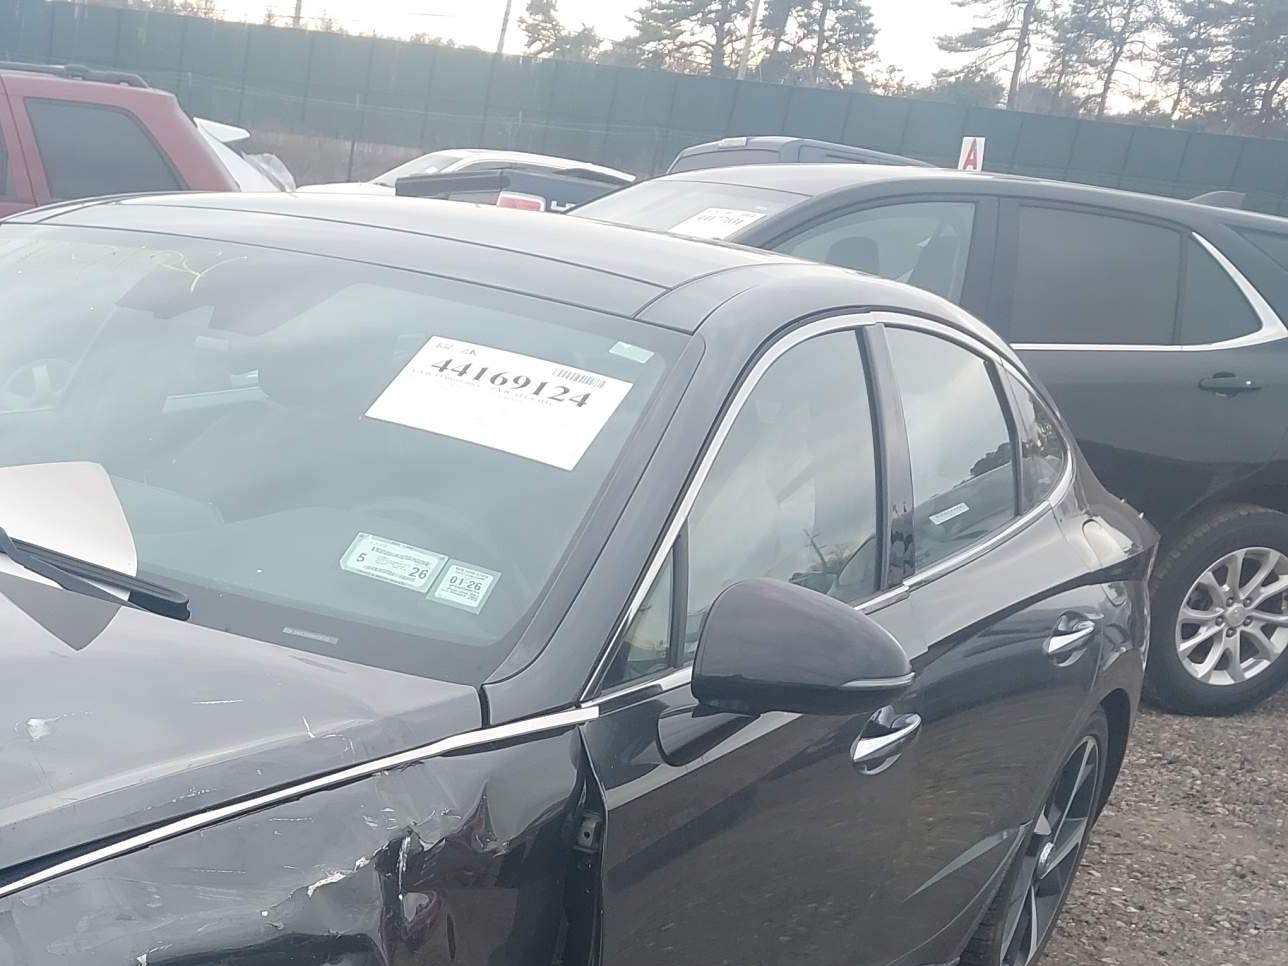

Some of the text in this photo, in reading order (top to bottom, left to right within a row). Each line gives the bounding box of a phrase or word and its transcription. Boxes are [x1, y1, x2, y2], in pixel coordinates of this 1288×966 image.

[962, 137, 978, 170] A
[431, 358, 592, 408] 44169124
[356, 552, 367, 563] 5
[409, 566, 430, 580] 26
